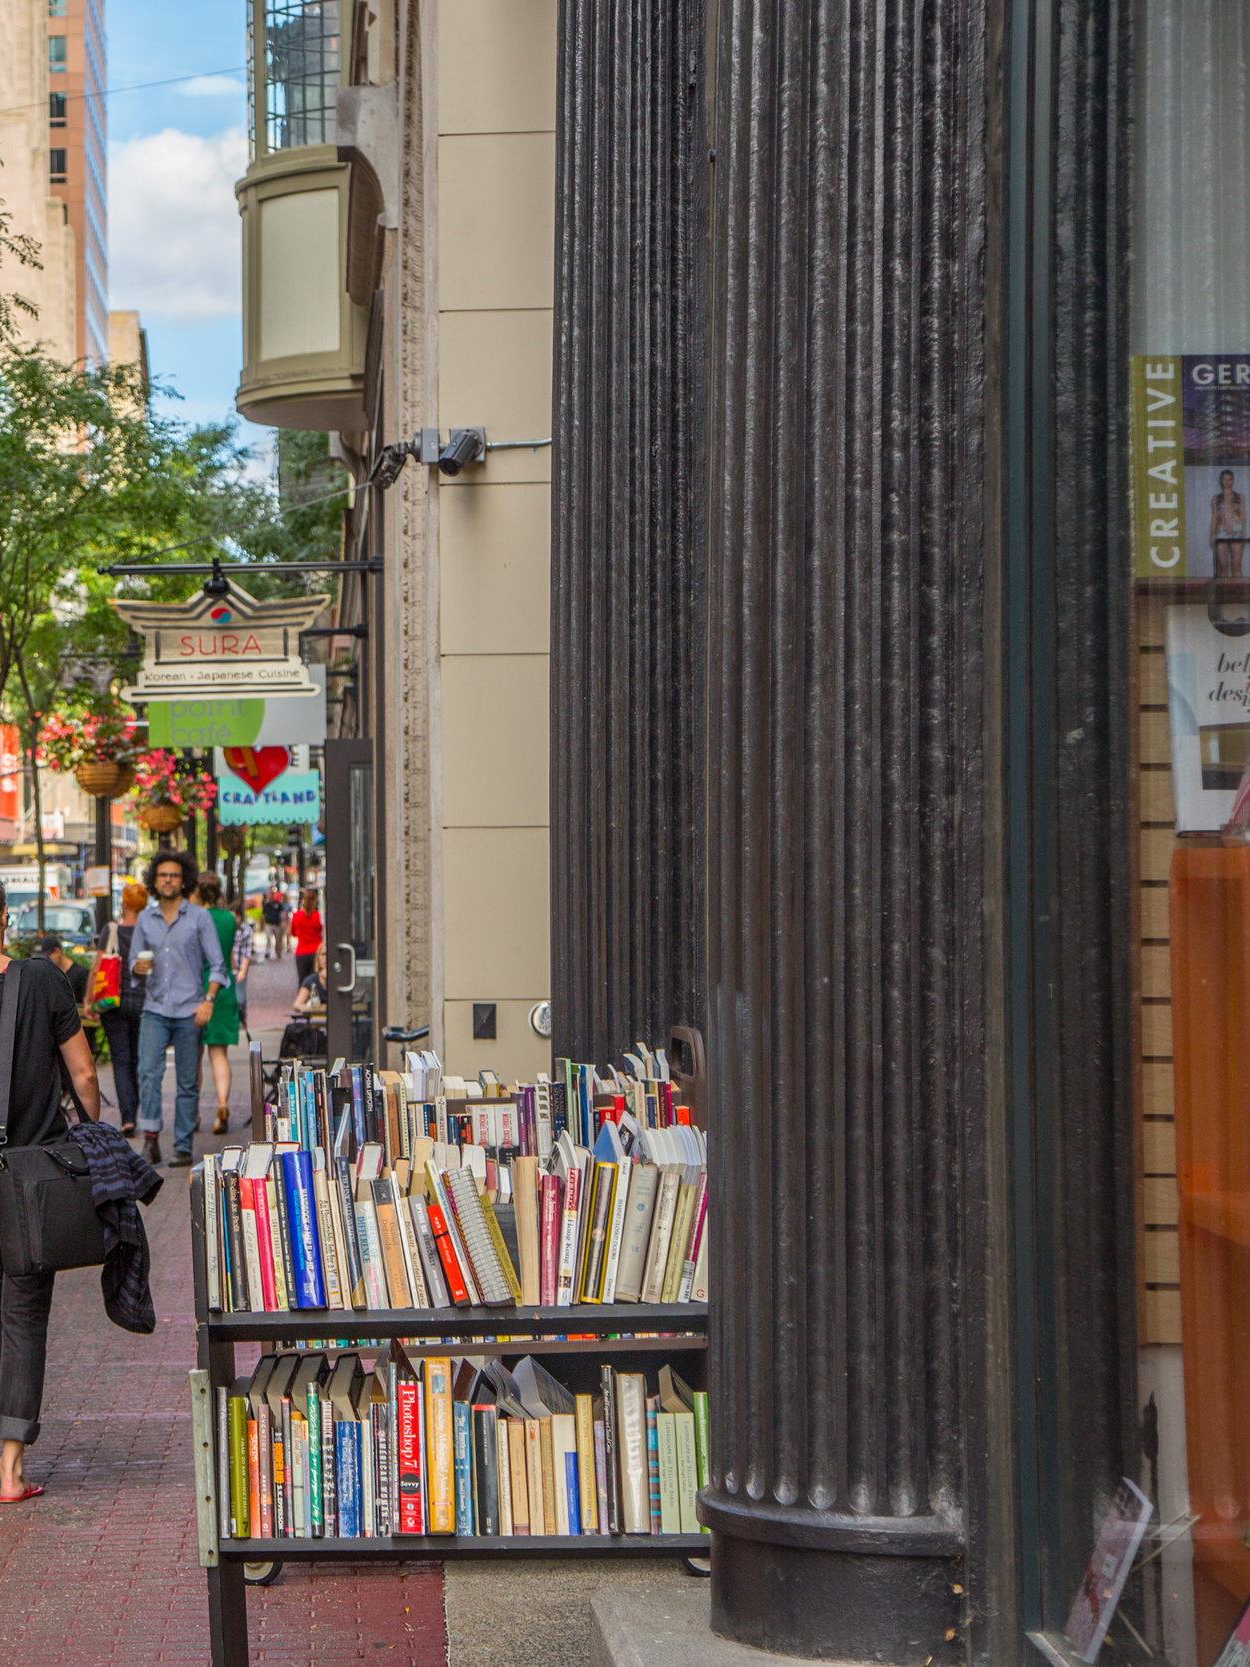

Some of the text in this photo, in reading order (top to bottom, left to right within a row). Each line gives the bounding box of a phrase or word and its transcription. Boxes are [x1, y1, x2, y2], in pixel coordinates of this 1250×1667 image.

[1146, 363, 1180, 568] CREATIVE
[180, 634, 262, 656] SURA
[145, 669, 300, 681] Korean Japanese Cuisine
[170, 699, 245, 728] point
[300, 1188, 310, 1223] HANDBOOK
[319, 1200, 328, 1209] An
[567, 1169, 577, 1210] Frommer's
[232, 1216, 240, 1232] Profit
[320, 1209, 332, 1242] Unsuitable
[357, 1216, 371, 1263] DIFFERENCE
[382, 1220, 391, 1251] Deronda
[415, 1203, 425, 1223] SPYING
[422, 1234, 436, 1266] DEMOCRACY
[613, 1220, 621, 1240] CLOSED
[325, 1244, 334, 1254] Job
[326, 1255, 335, 1263] for
[563, 1219, 573, 1265] Hong Kong
[611, 1241, 619, 1260] DOORS
[405, 1221, 427, 1306] Babbitt Sinclair Lewis
[401, 1390, 417, 1468] Photoshop 7
[274, 1442, 284, 1484] BORDERLAND
[437, 1398, 448, 1499] Introductory Mathematical Analysis
[379, 1438, 388, 1518] AMERICAN WOMAN
